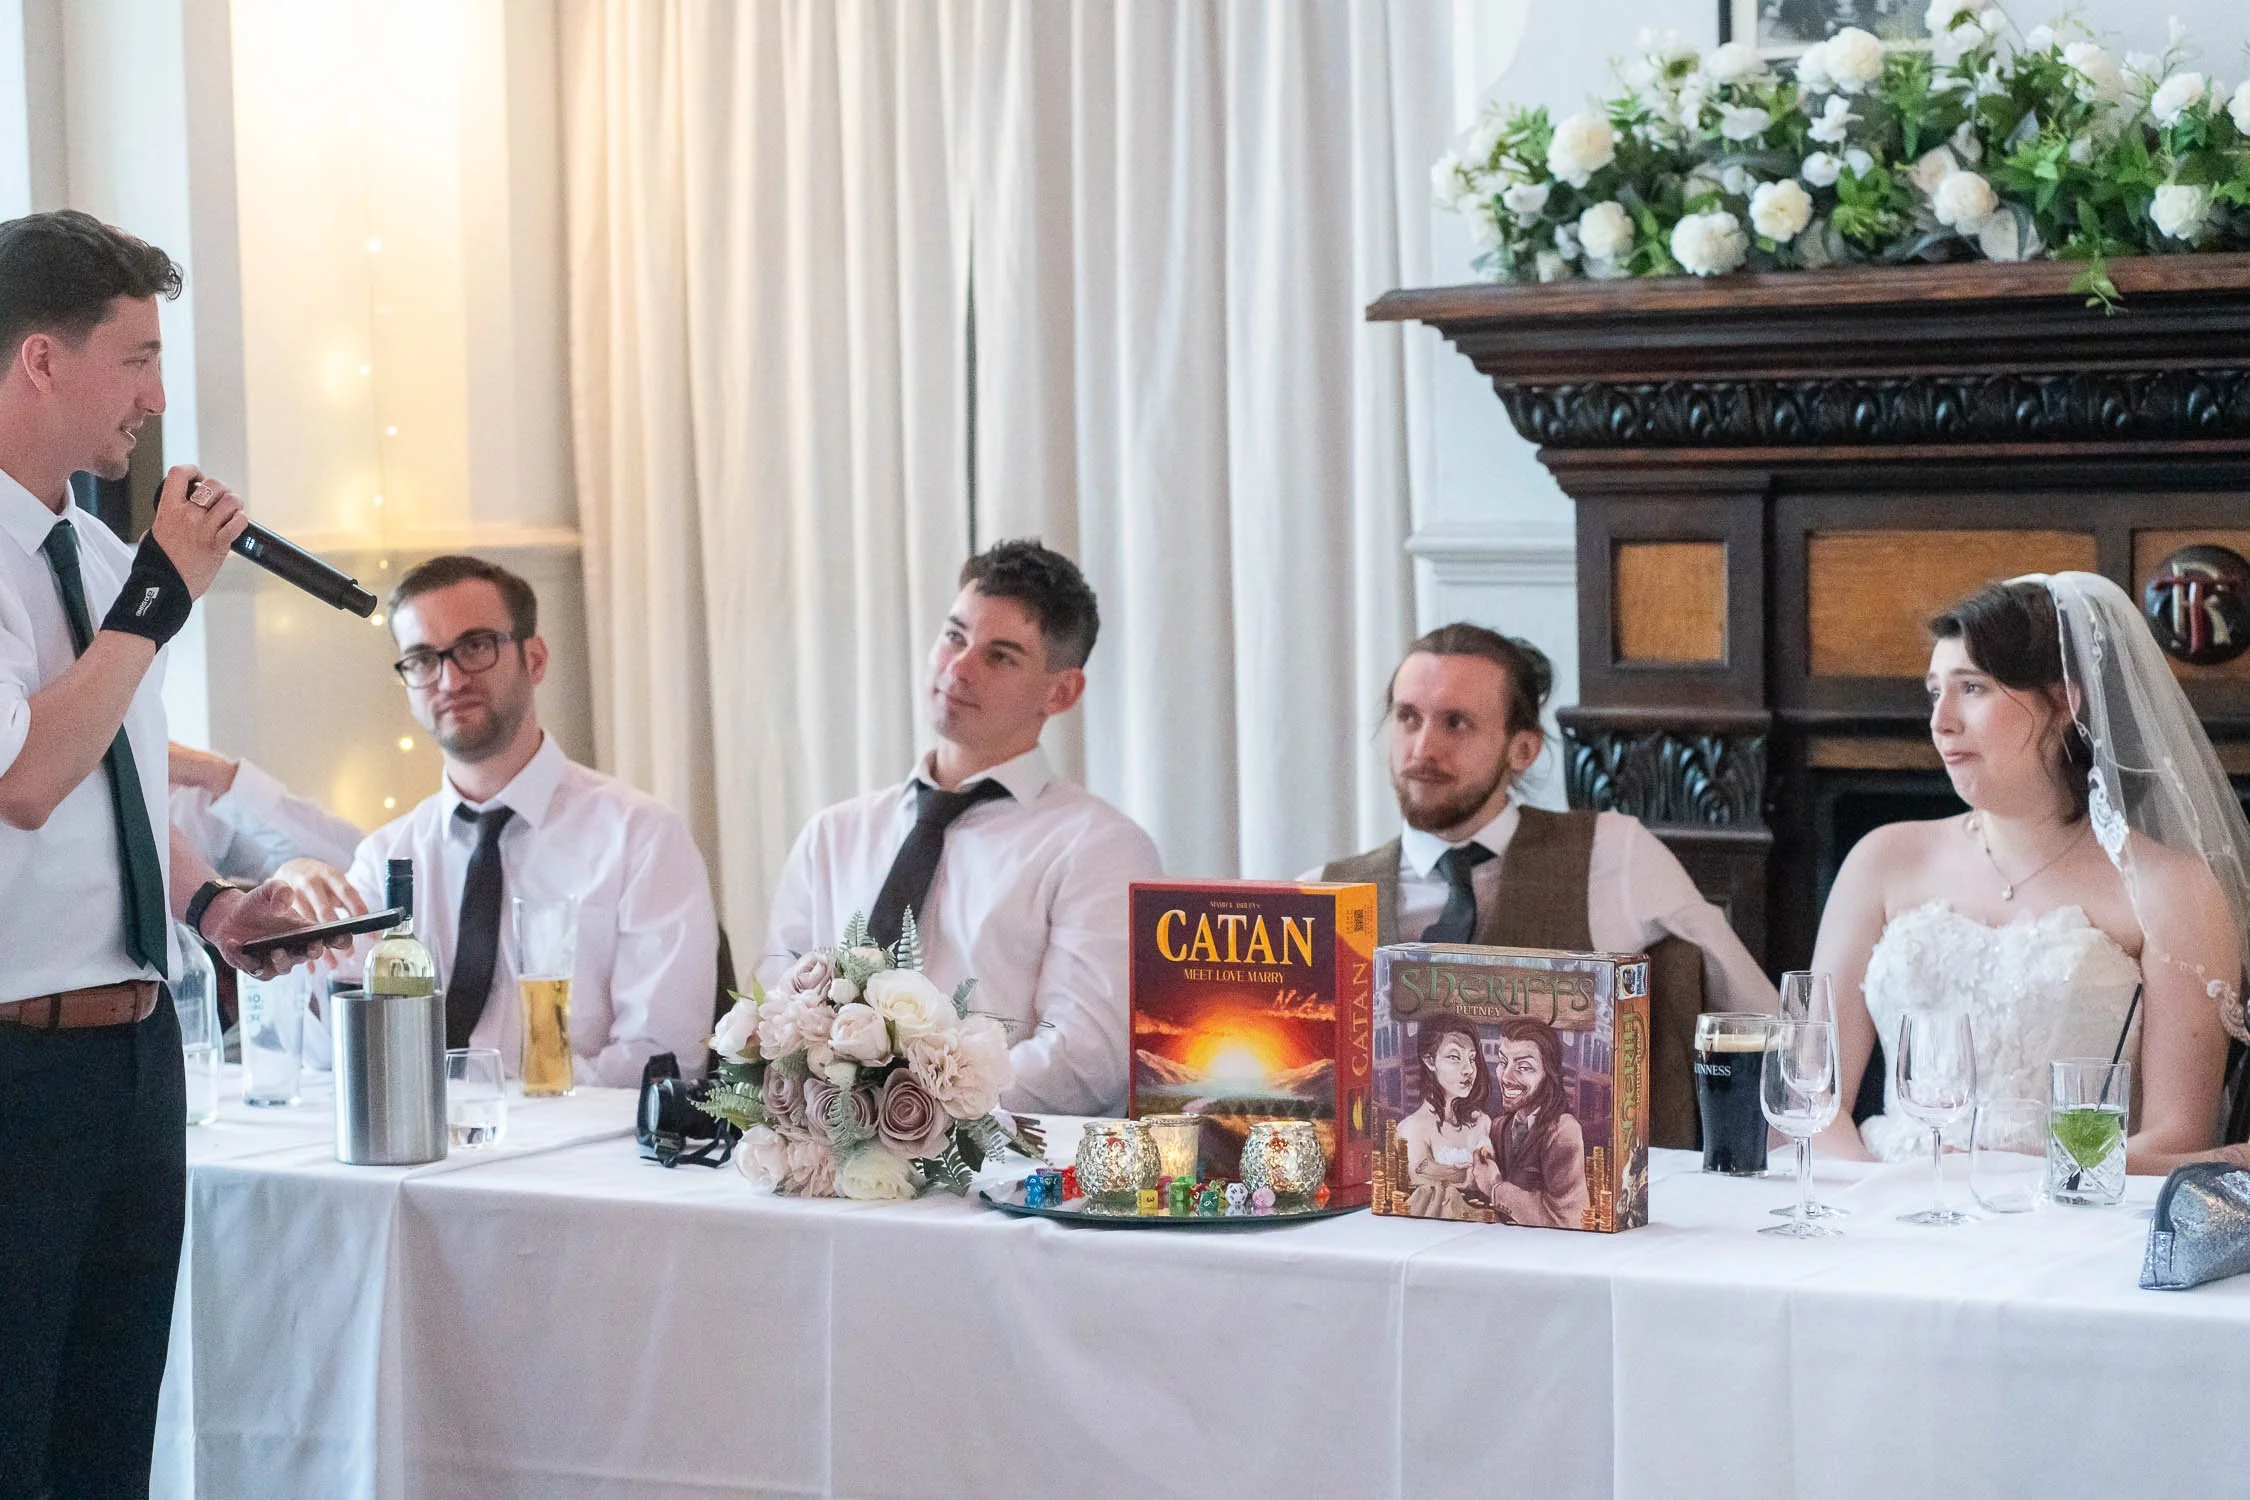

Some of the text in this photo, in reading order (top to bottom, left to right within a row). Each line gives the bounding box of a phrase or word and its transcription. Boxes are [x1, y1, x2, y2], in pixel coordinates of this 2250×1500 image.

[1156, 909, 1315, 967] CATAN
[1184, 968, 1285, 984] MEET LOVE MARRY
[1352, 962, 1369, 1077] CATAN
[1455, 1005, 1501, 1017] PUTNEY
